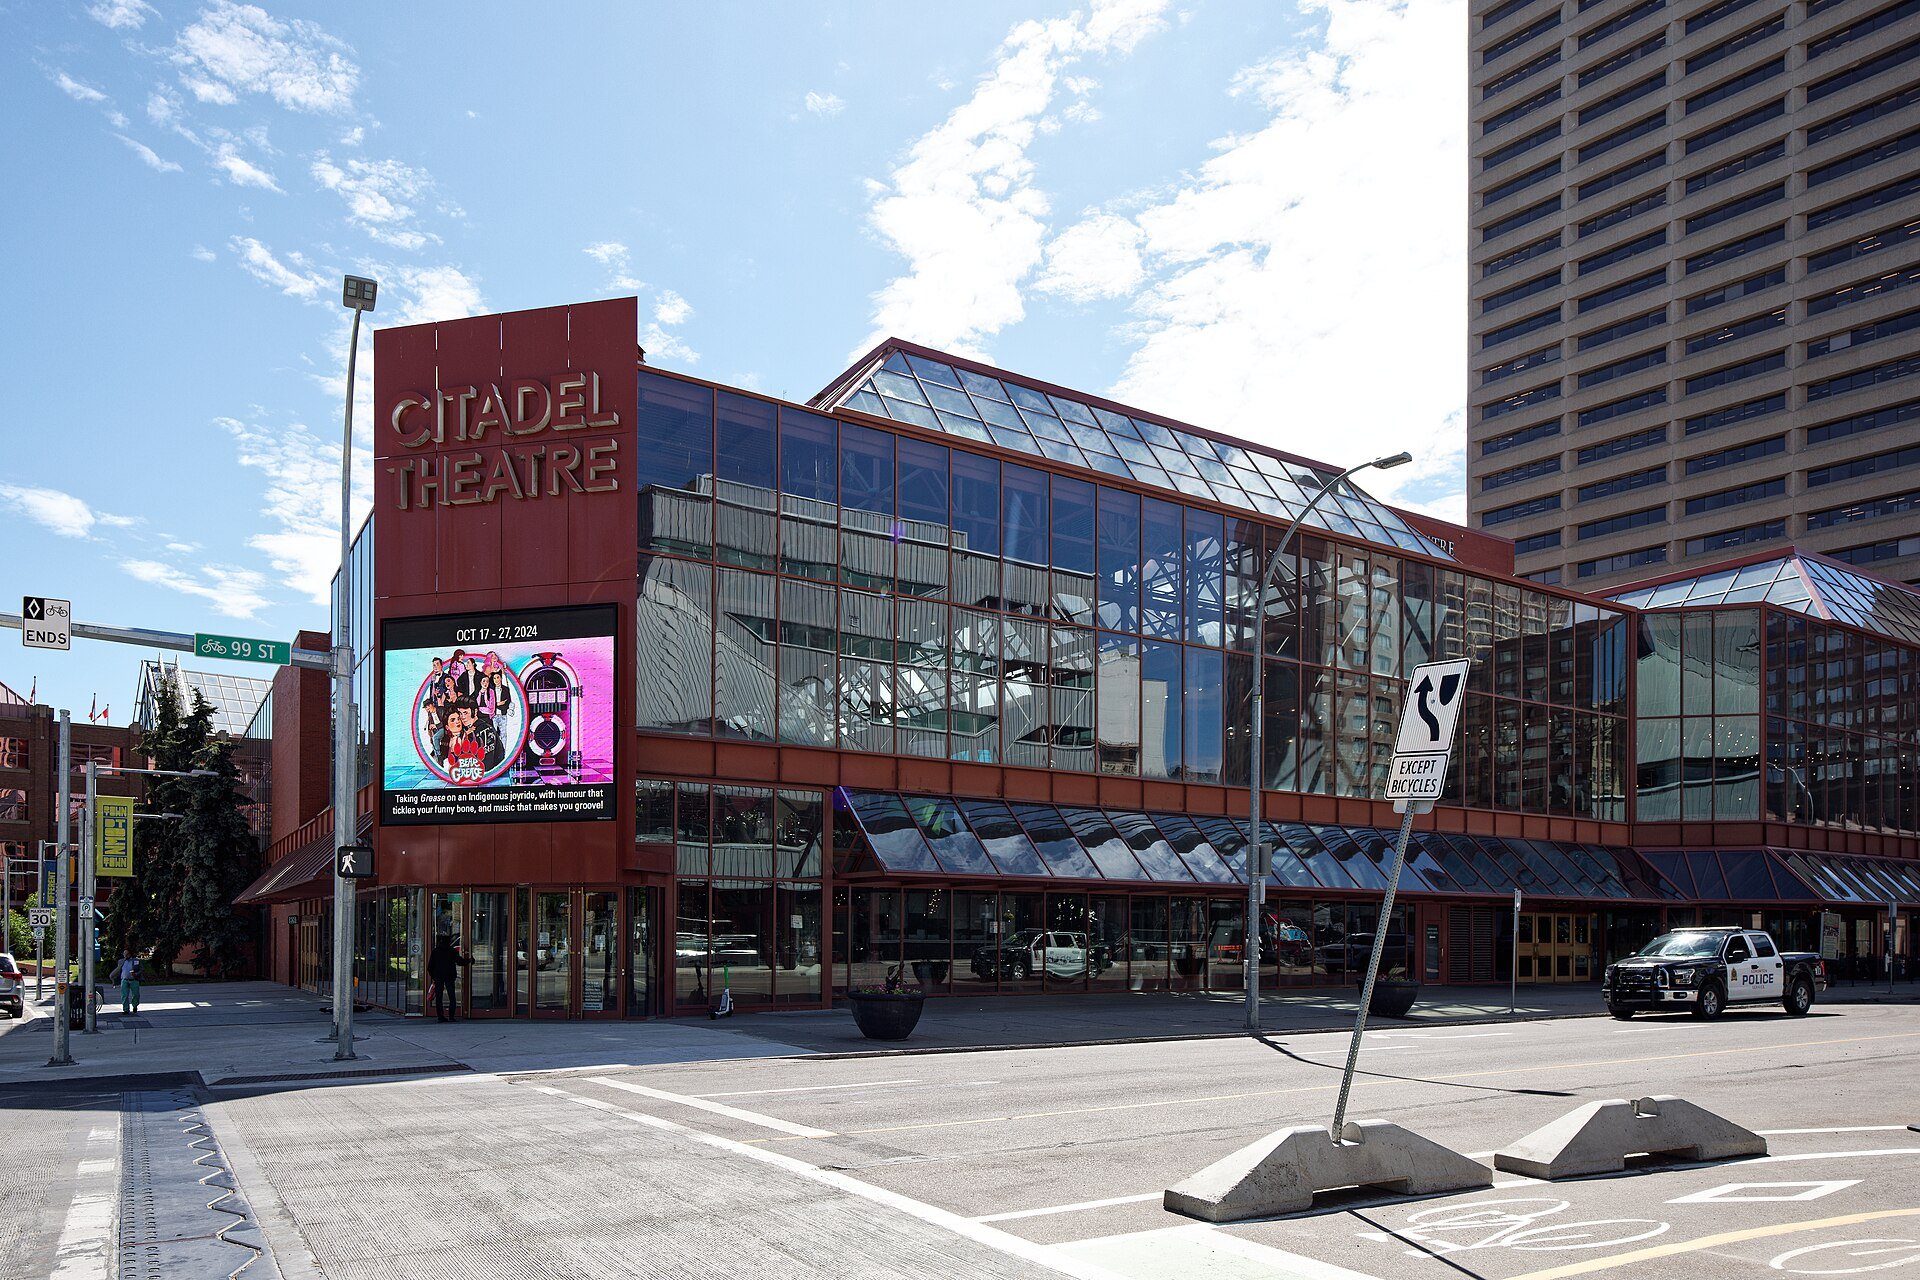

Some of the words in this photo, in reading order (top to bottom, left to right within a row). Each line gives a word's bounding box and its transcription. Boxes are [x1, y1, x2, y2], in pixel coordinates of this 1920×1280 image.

[386, 370, 620, 448] CITADEL
[386, 438, 618, 510] THEATRE
[26, 629, 67, 645] ENDS
[456, 628, 476, 642] OCT
[479, 628, 489, 640] 17
[498, 626, 512, 640] 27,
[514, 624, 538, 638] 2024
[231, 641, 252, 657] 99
[258, 644, 276, 660] ST
[459, 757, 480, 768] BEAR
[1399, 759, 1437, 775] EXCEPT
[451, 767, 483, 784] GREASE
[1391, 778, 1438, 793] BICYCLES
[395, 794, 418, 805] Taking
[420, 793, 446, 803] Grease
[468, 792, 508, 803] Indigenous
[509, 791, 538, 802] joyride,
[539, 790, 556, 800] with
[557, 789, 586, 799] humour
[587, 788, 604, 798] that
[392, 805, 416, 815] tickles
[417, 806, 433, 816] your
[434, 804, 455, 815] funny
[456, 804, 477, 814] bone,
[478, 803, 492, 812] and
[493, 802, 516, 812] music
[516, 802, 532, 811] that
[533, 801, 558, 811] makes
[559, 802, 573, 812] you
[574, 800, 604, 812] groove!
[31, 914, 49, 925] 30
[1742, 973, 1774, 985] POLICE
